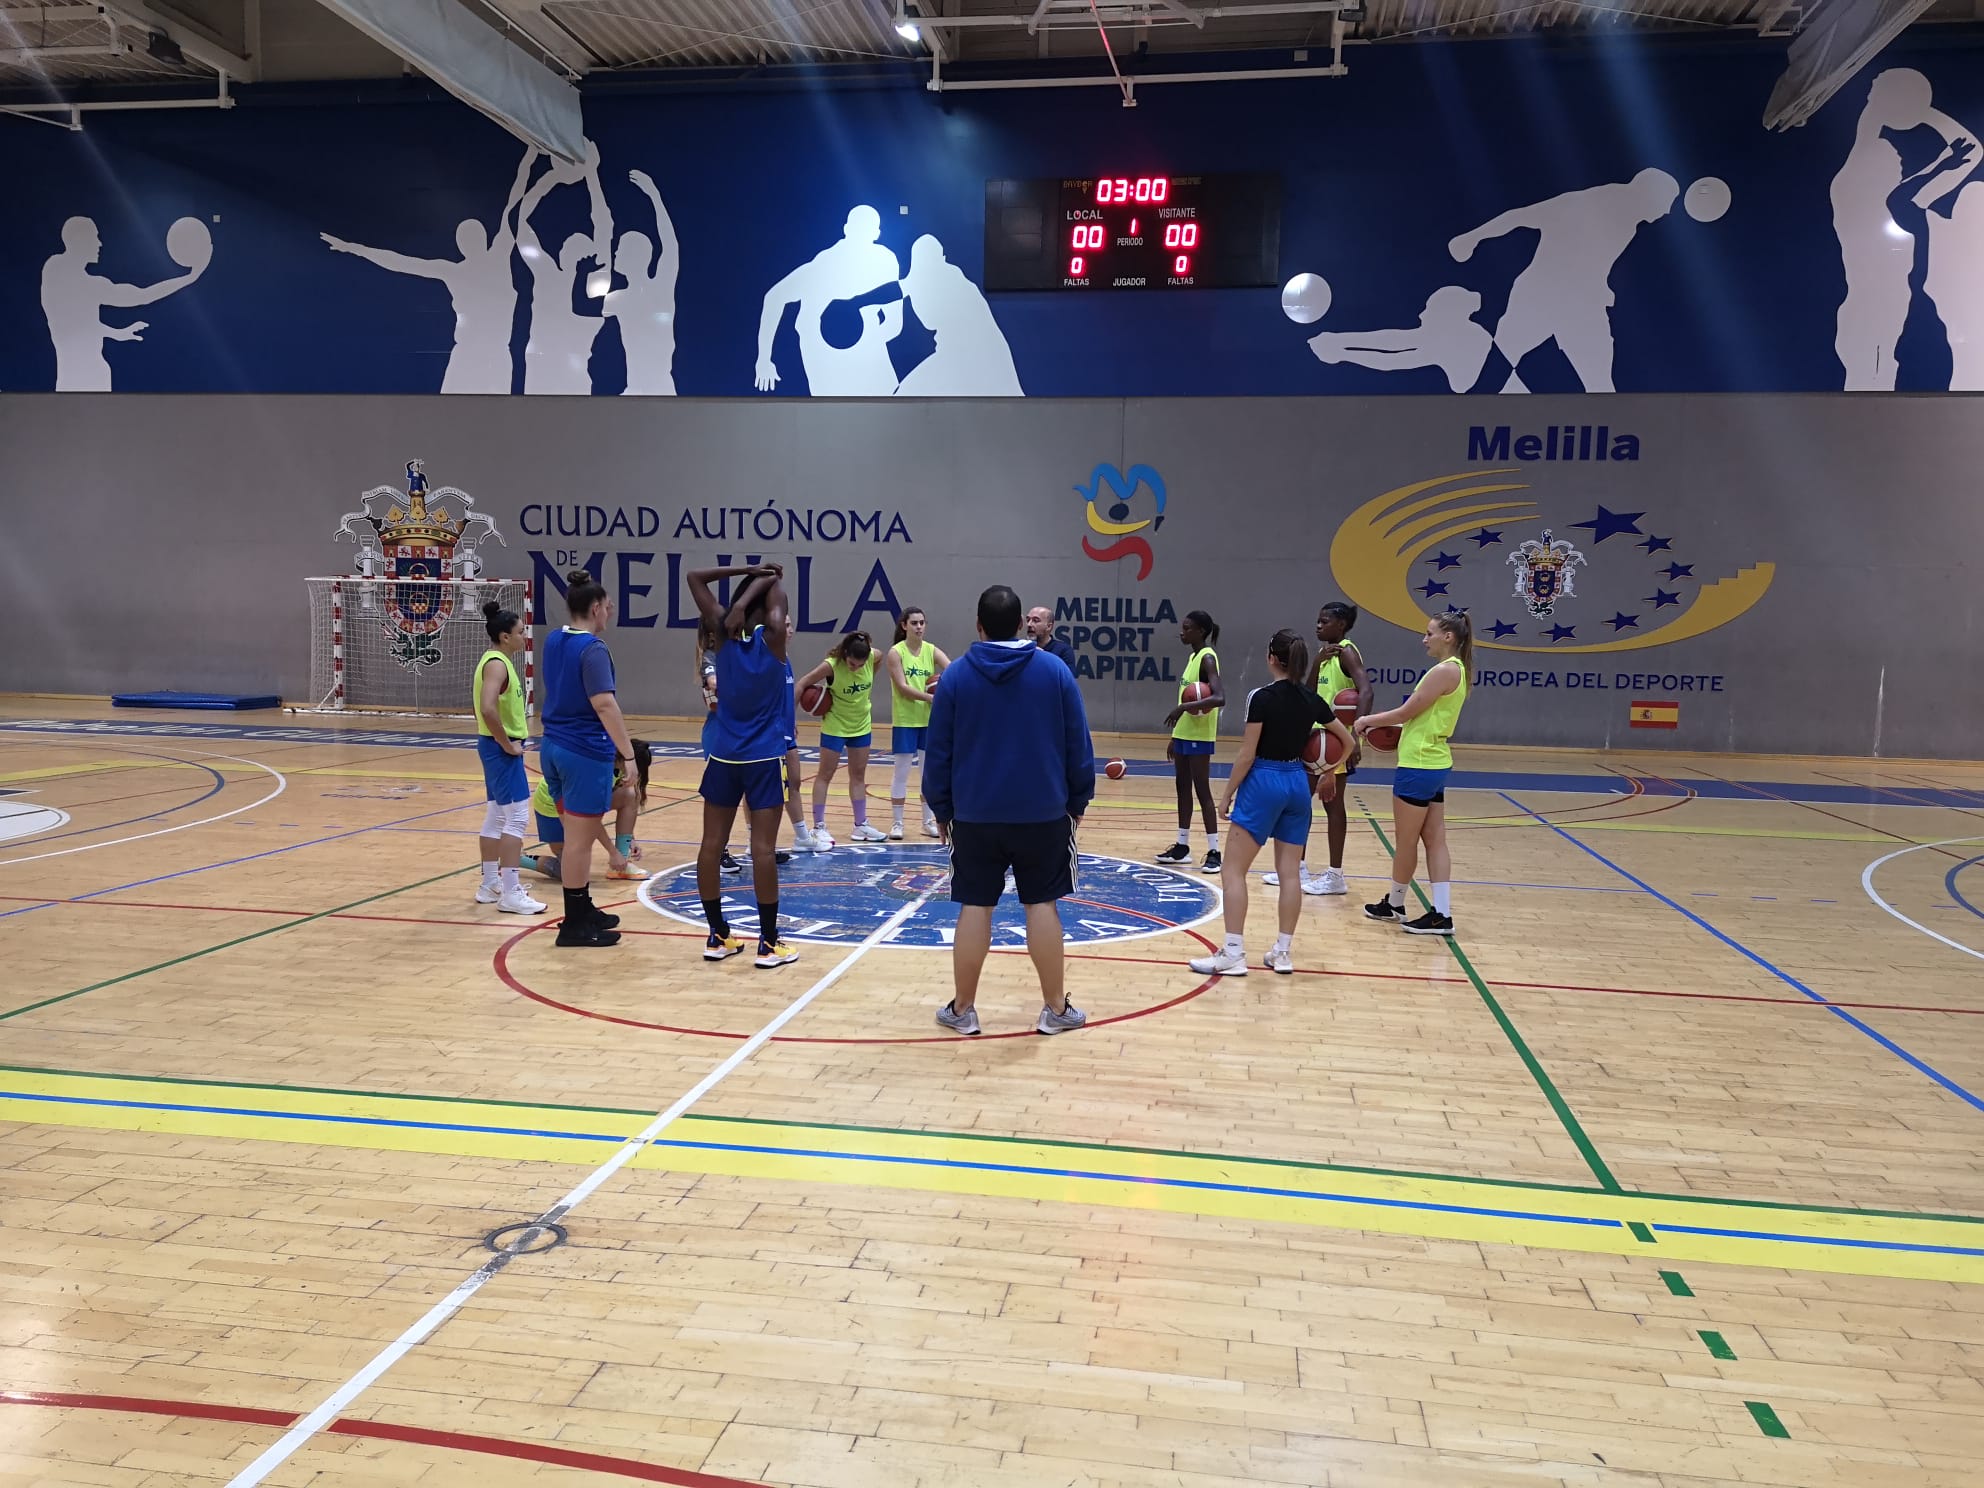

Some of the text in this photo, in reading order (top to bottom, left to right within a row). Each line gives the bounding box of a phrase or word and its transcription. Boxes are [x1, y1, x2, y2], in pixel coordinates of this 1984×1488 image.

[1097, 178, 1167, 202] 03:00
[1066, 209, 1104, 220] LOCAL
[1158, 207, 1196, 218] VISITANTE
[1130, 218, 1137, 234] 1
[1165, 223, 1197, 247] 00
[1072, 225, 1104, 248] 00
[1117, 237, 1144, 246] PERIODO
[1071, 257, 1083, 274] 0
[1175, 255, 1188, 272] 0
[1063, 278, 1090, 287] FALTAS
[1112, 277, 1147, 287] JUGADOR
[1167, 276, 1194, 285] FALTAS
[1466, 425, 1641, 462] Melilla
[519, 499, 913, 544] CIUDAD AUTÓNOMA
[556, 549, 579, 567] DE
[526, 550, 903, 634] MELILA
[1054, 596, 1179, 624] MELILLA
[1054, 625, 1155, 652] SPORT
[1074, 654, 1177, 682] APITAL
[1366, 667, 1724, 692] CIUDA UROPEA DEL DEPORTE
